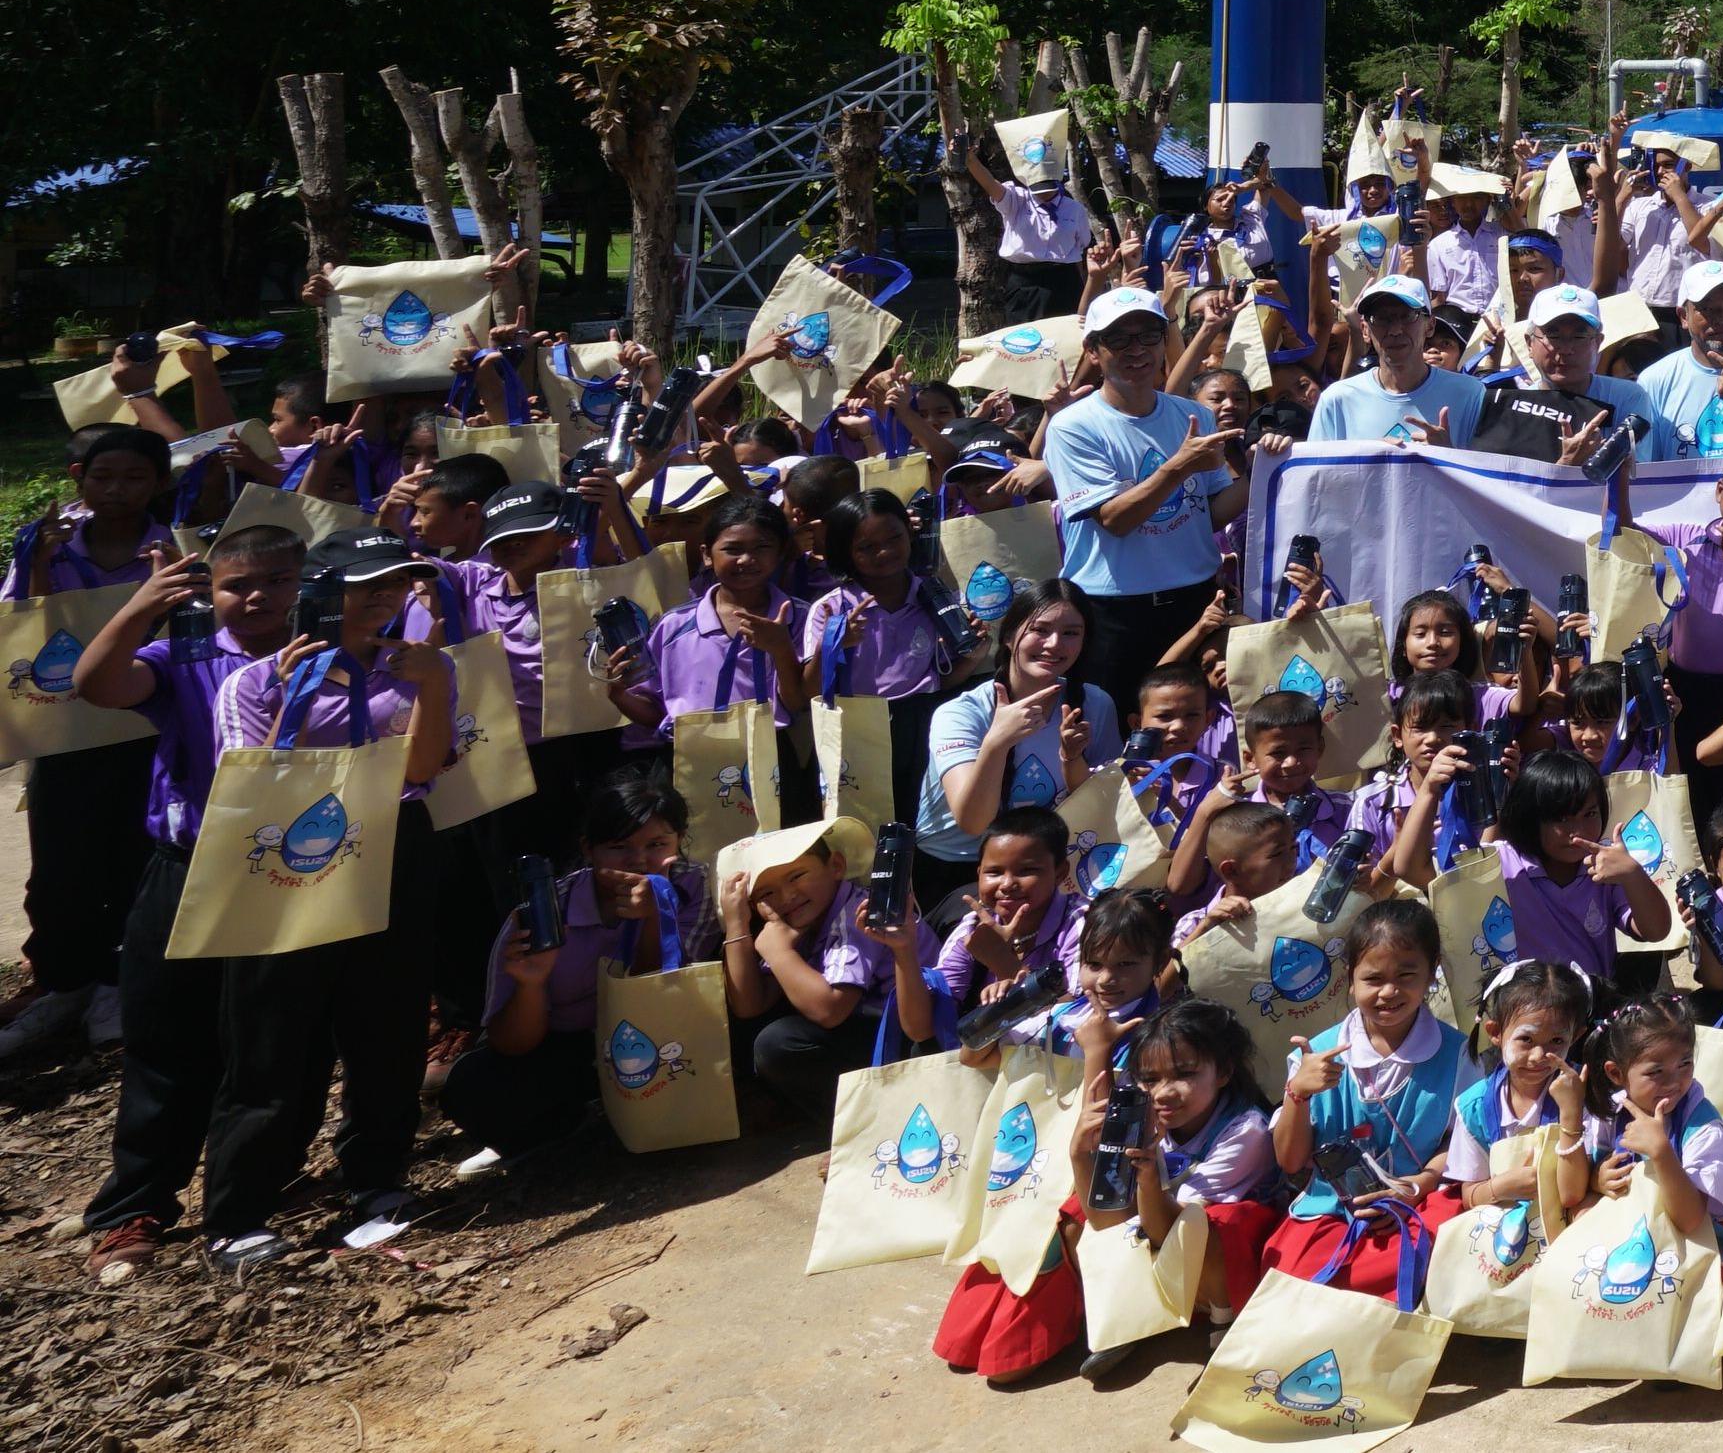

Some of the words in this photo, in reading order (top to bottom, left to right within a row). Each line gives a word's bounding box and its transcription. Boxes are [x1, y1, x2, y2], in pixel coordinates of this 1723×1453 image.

[1511, 399, 1573, 425] ISUZU
[486, 494, 534, 520] ISUZU
[290, 856, 333, 869] ISUZU
[1295, 975, 1328, 999] ISUZU
[906, 1166, 938, 1178] ISUZU
